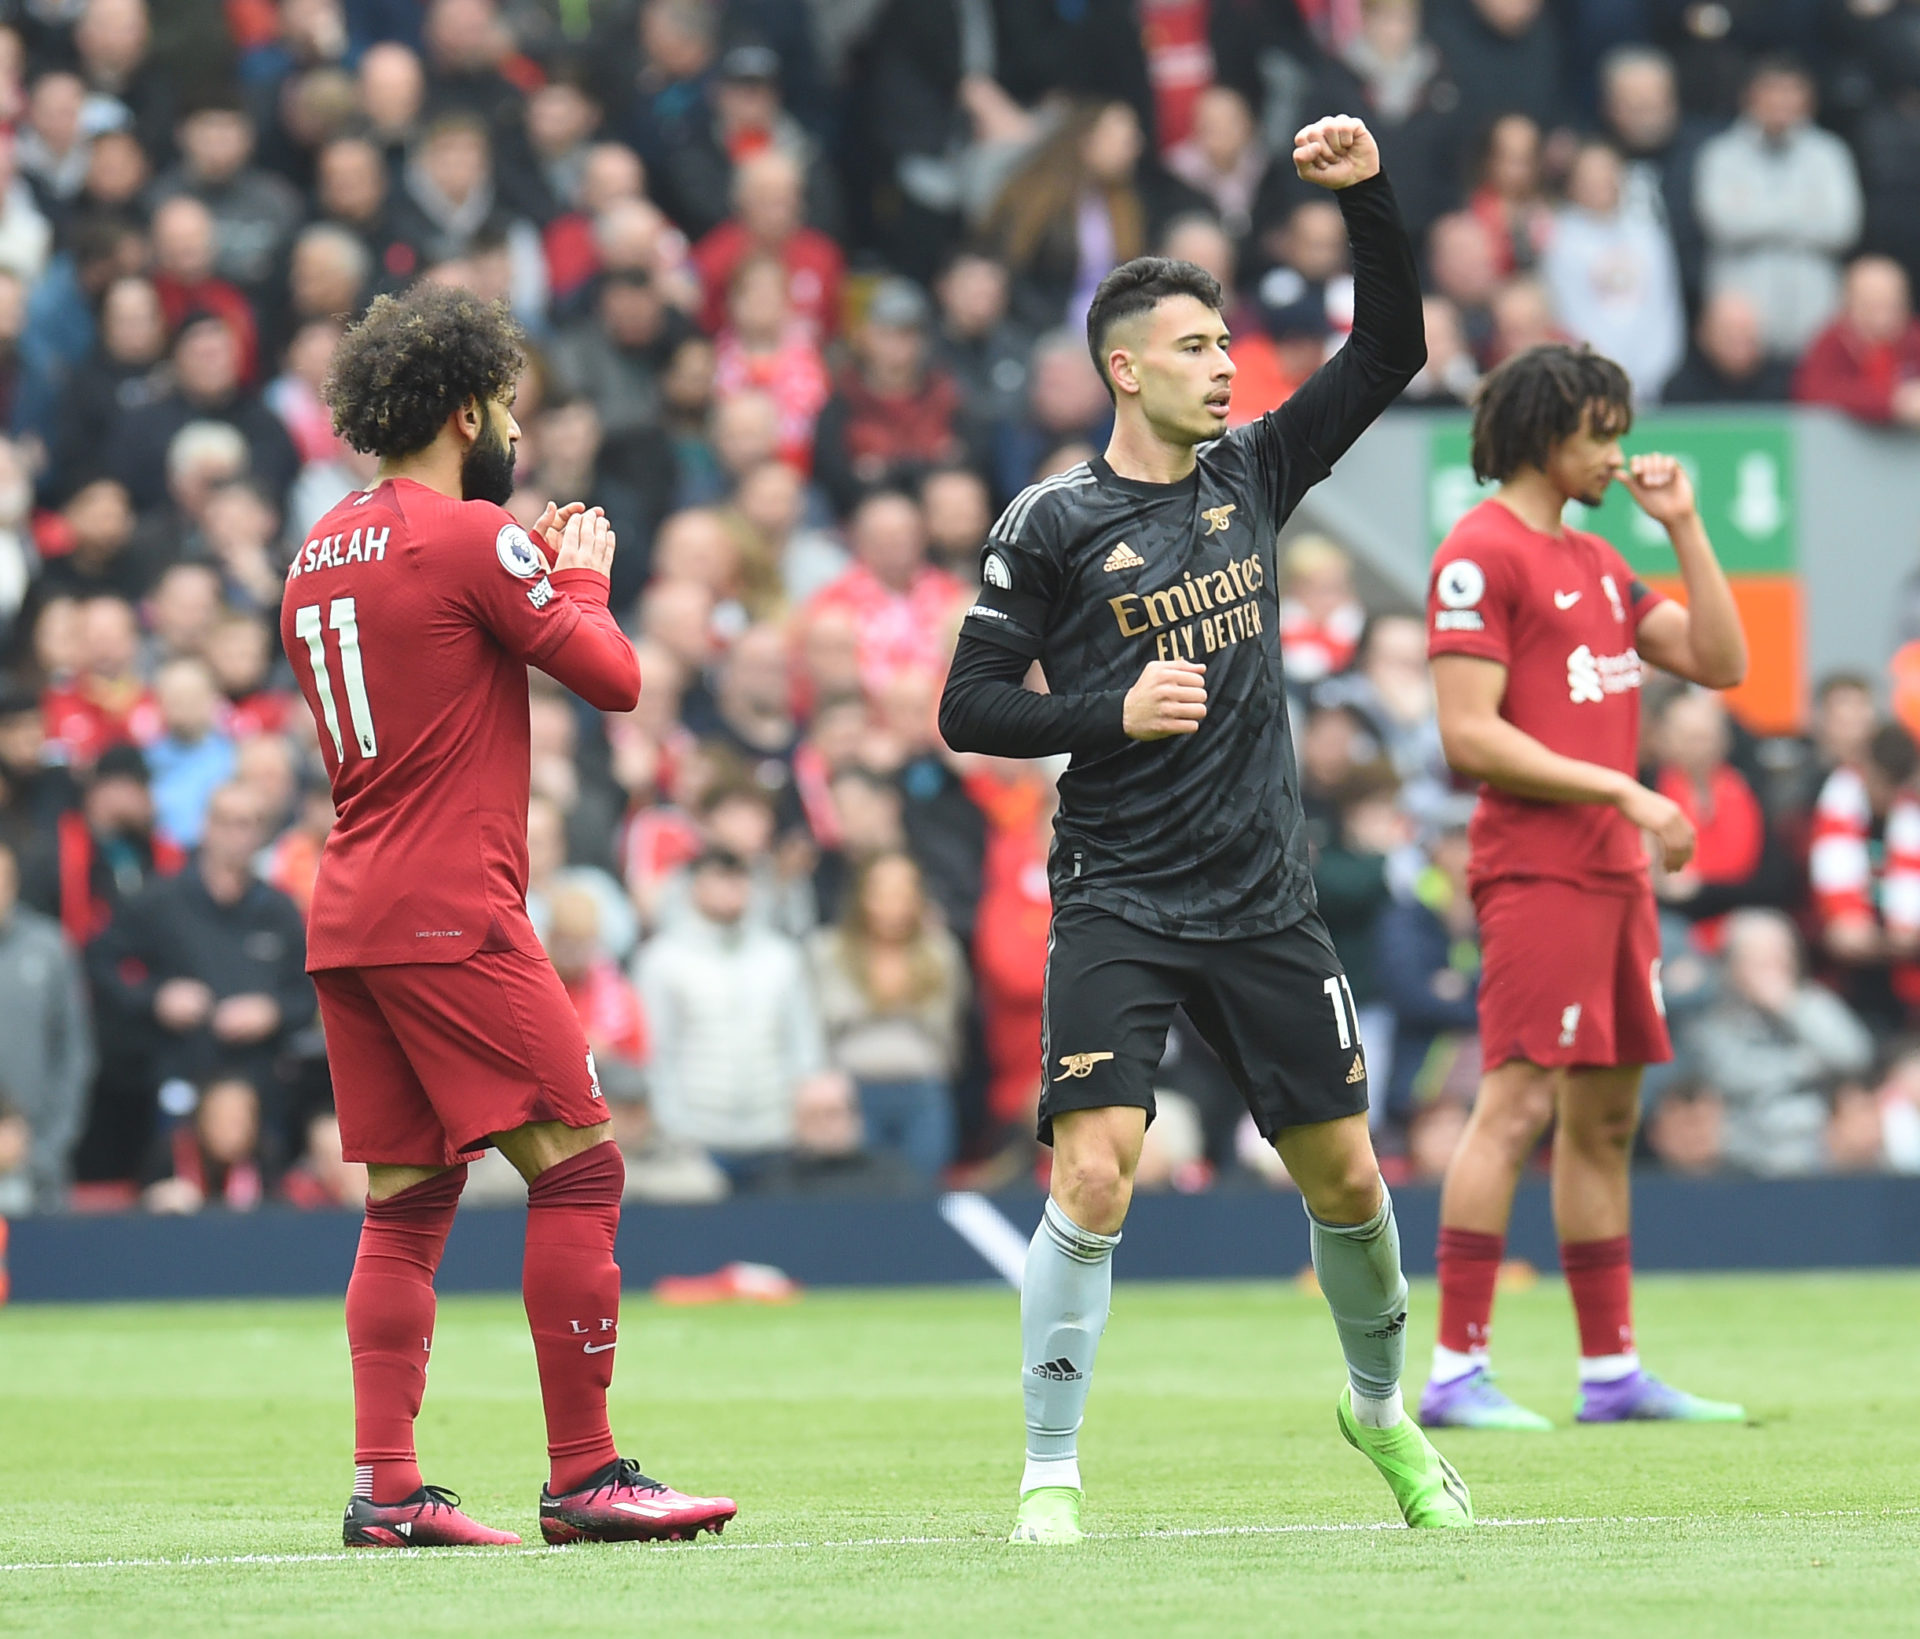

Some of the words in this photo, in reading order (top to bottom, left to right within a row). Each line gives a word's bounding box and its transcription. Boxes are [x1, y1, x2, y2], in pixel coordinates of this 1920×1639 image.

[304, 526, 390, 573] SALAH
[1103, 556, 1145, 573] adidas
[1109, 553, 1264, 637] Emirates
[1201, 600, 1263, 654] BETTER
[295, 597, 378, 765] 11
[1323, 973, 1362, 1050] 11
[1031, 1366, 1083, 1381] adidas
